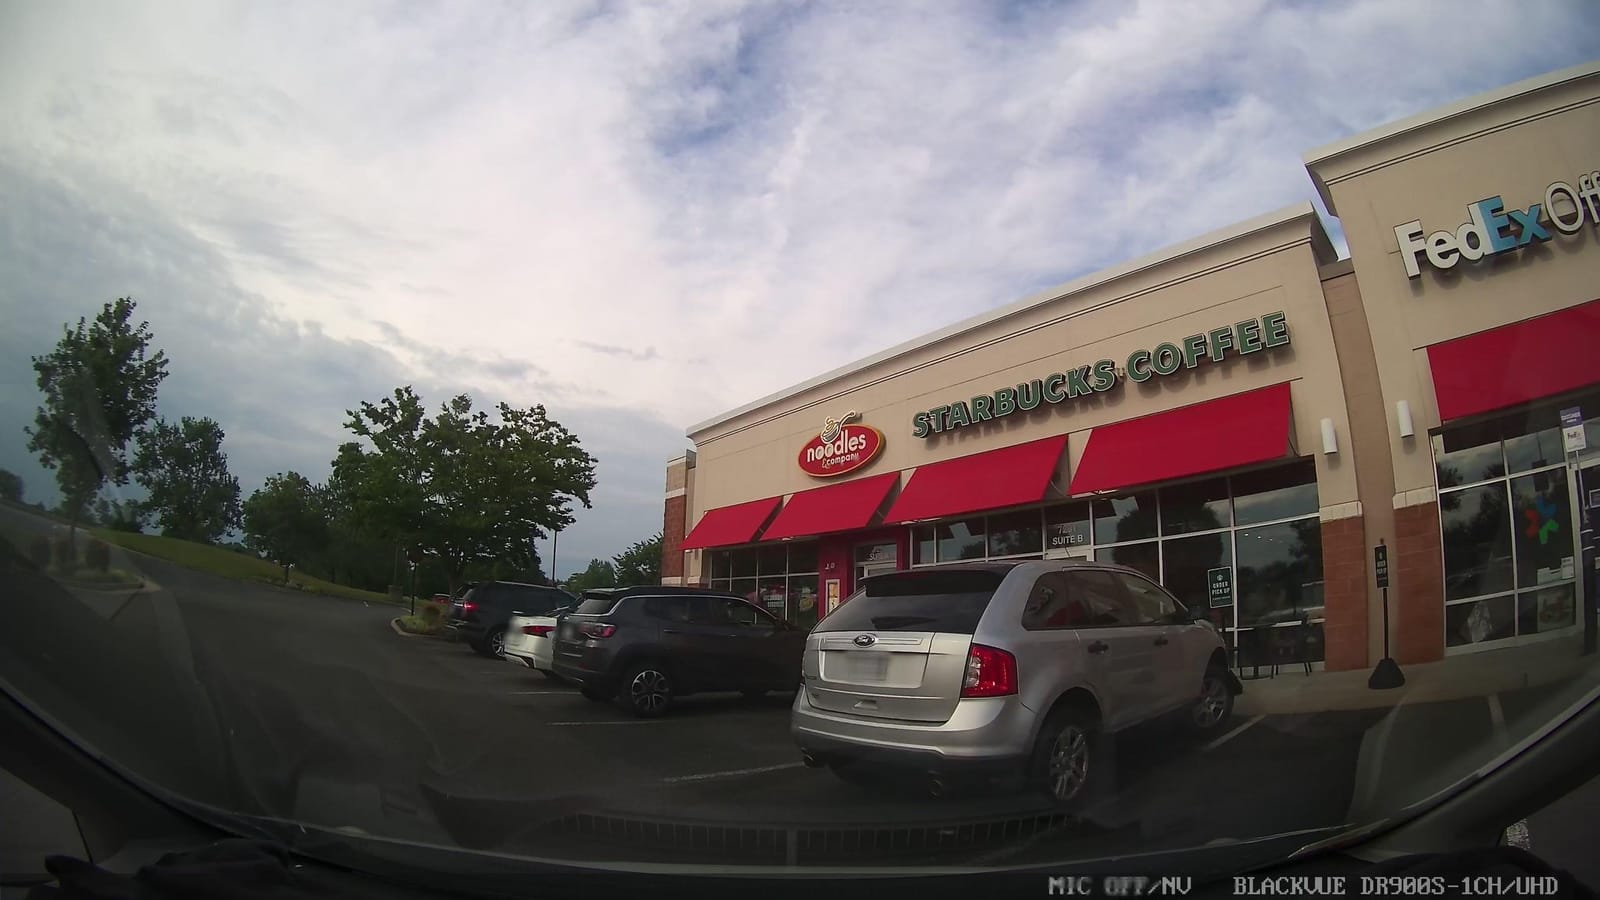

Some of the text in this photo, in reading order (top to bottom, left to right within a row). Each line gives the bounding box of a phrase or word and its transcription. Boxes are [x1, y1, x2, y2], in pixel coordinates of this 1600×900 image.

[1393, 195, 1552, 280] FedEx
[912, 310, 1290, 438] STARBUCKS COFFEE
[807, 429, 866, 462] noodles
[1052, 534, 1083, 546] SUITE B
